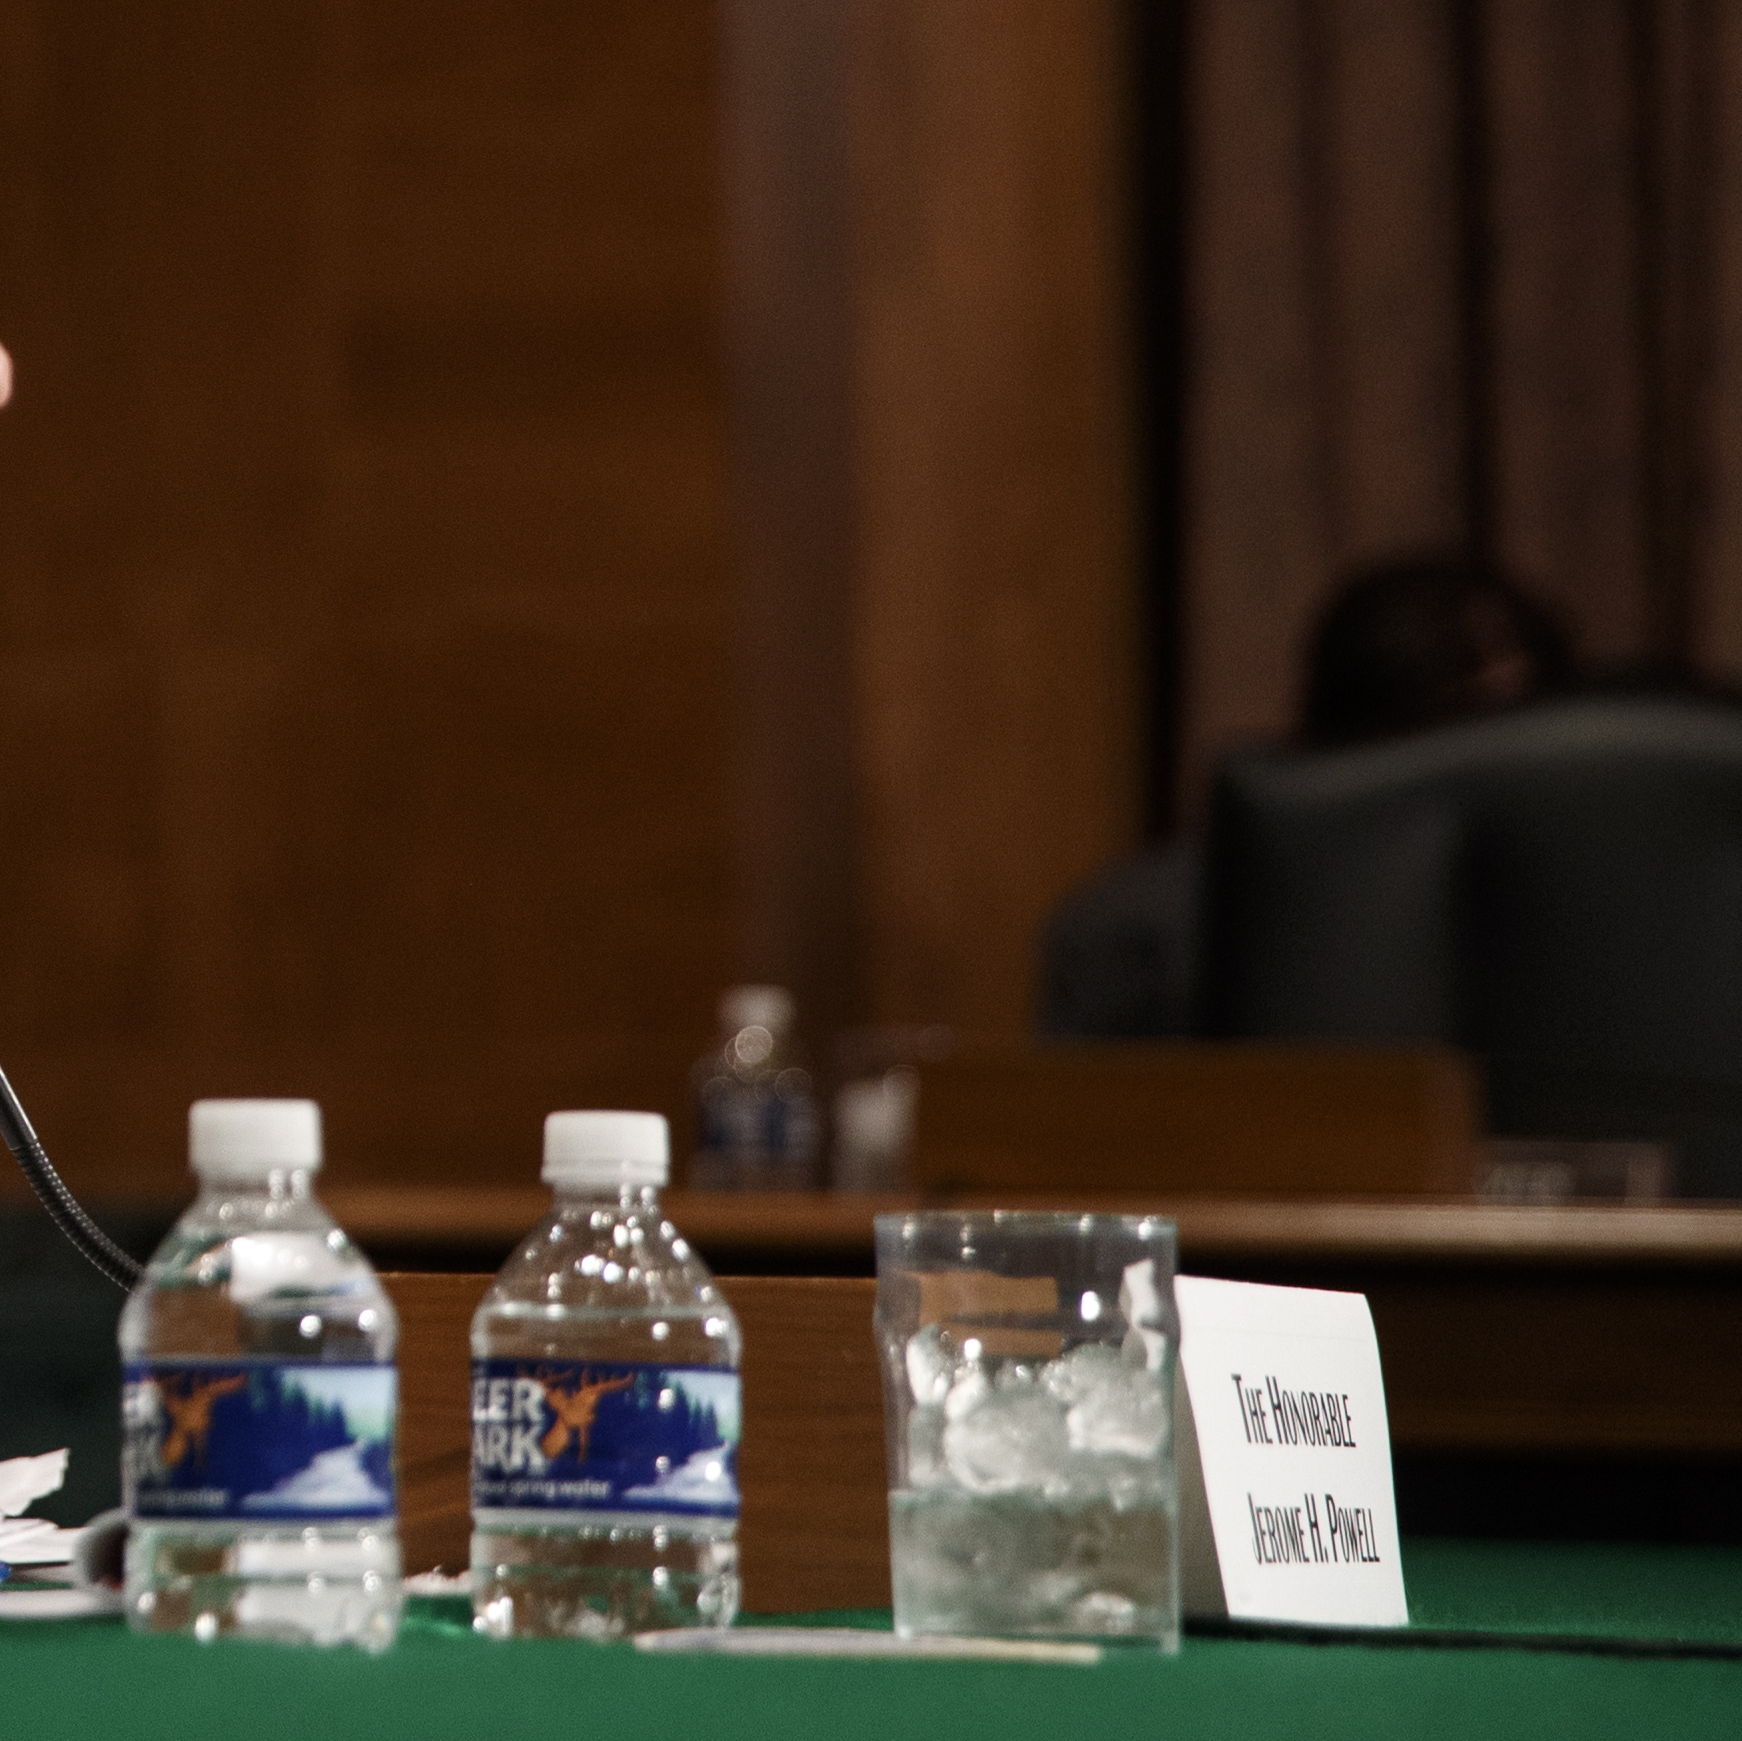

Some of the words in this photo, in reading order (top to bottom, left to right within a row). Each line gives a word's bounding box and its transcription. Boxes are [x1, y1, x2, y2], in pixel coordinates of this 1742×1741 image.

[1230, 1373, 1273, 1445] THE
[1265, 1375, 1357, 1448] HONORABLE
[1246, 1491, 1310, 1565] JEROME
[1304, 1492, 1329, 1563] H.
[1324, 1493, 1381, 1564] POWELL
